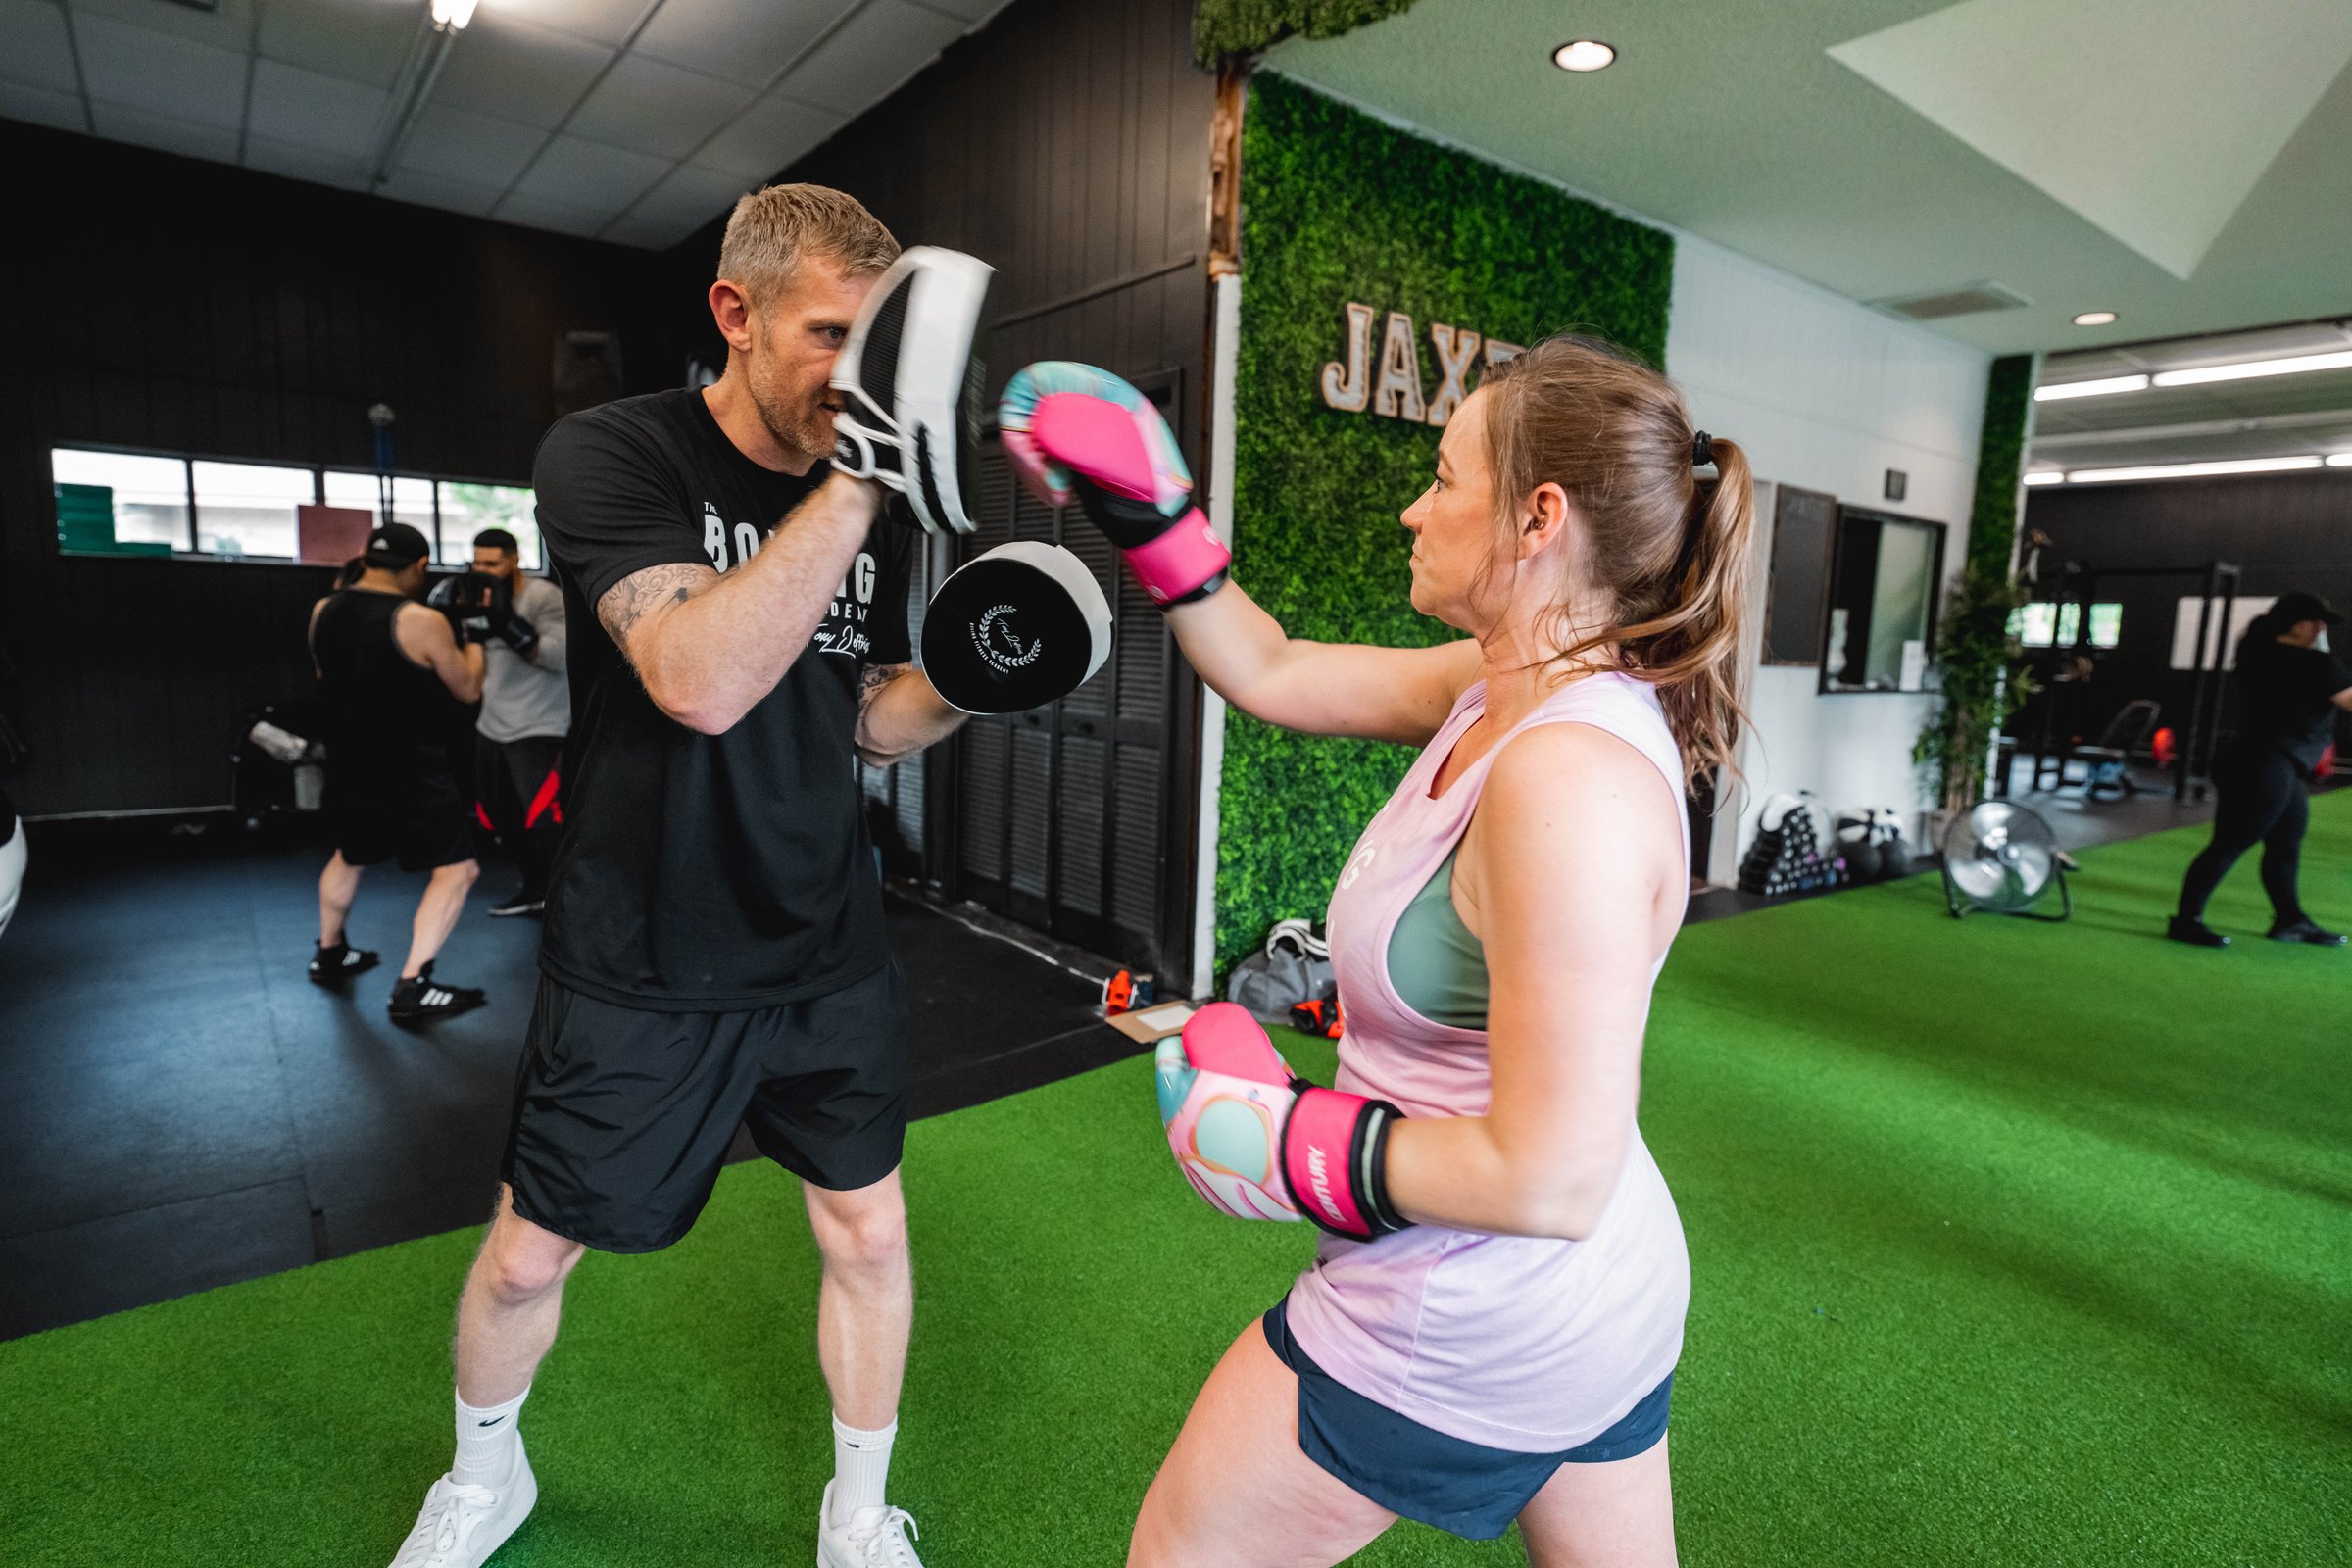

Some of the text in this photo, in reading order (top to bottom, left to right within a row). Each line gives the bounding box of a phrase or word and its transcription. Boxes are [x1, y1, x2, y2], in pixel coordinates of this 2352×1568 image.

[1321, 302, 1526, 427] JAX
[974, 641, 989, 660] FITNESS
[988, 660, 1009, 674] ACADEMY
